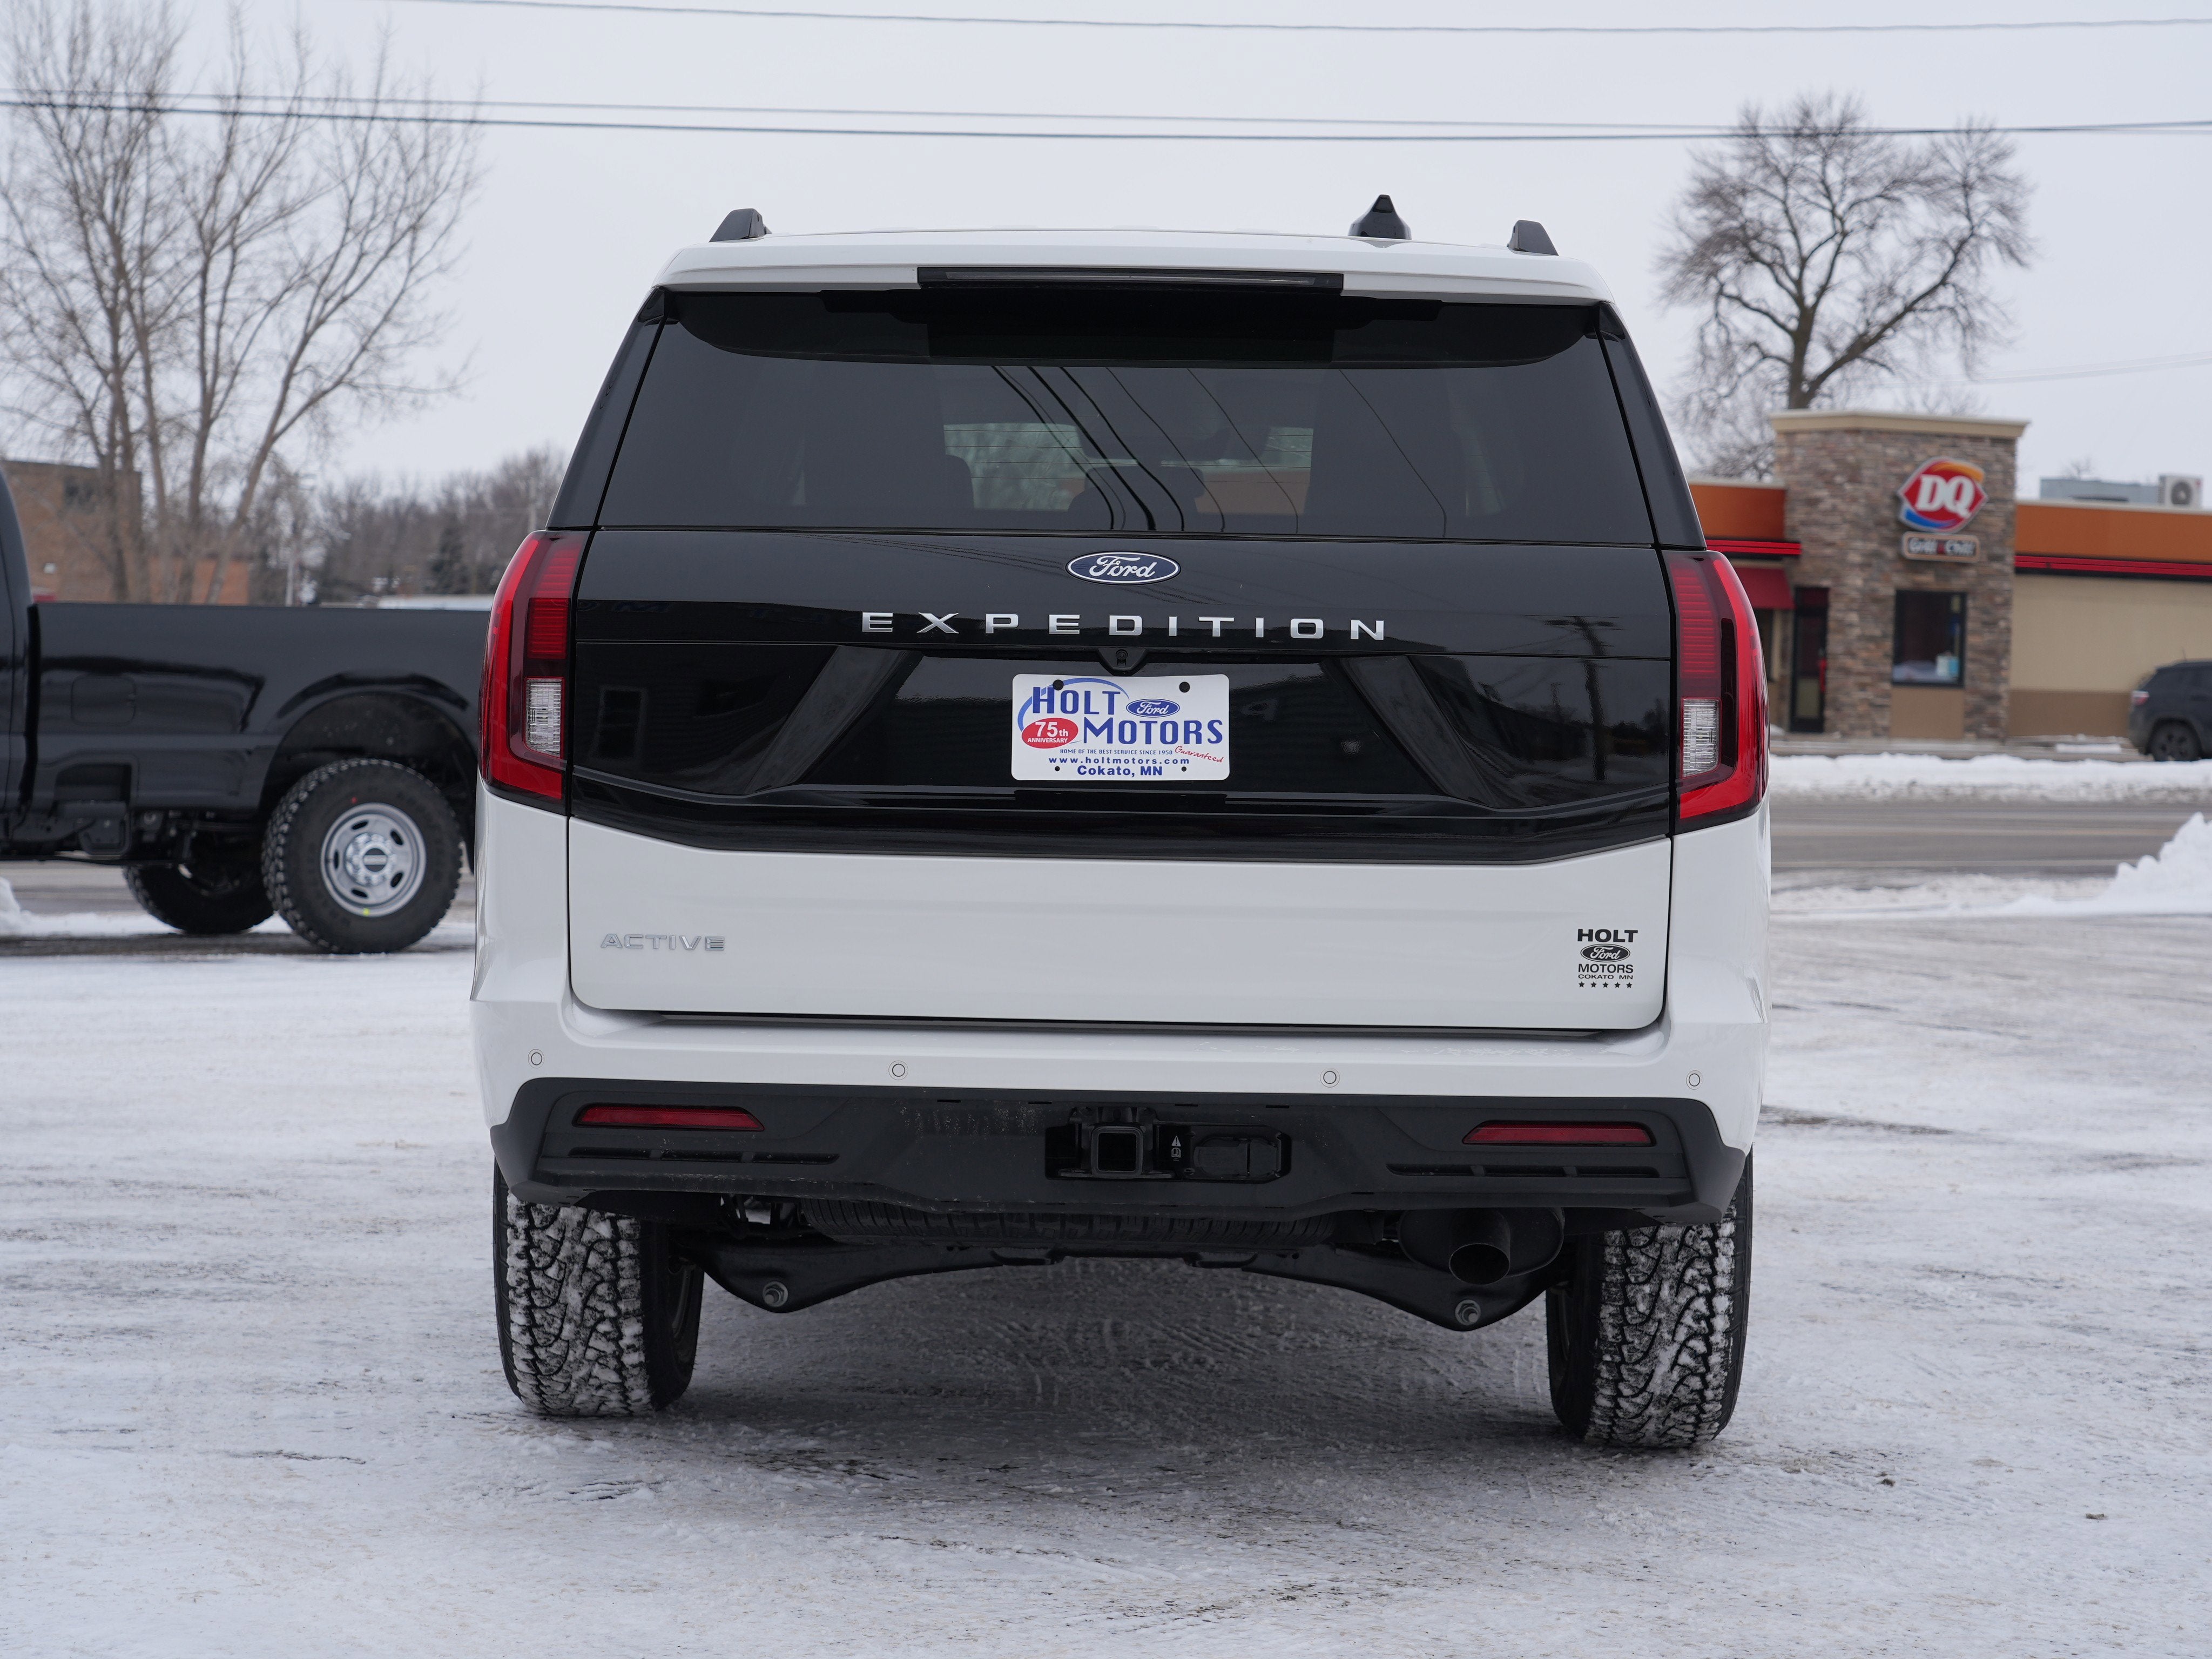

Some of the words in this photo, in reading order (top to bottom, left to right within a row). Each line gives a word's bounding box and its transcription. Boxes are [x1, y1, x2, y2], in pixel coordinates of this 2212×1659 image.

[1915, 474, 1975, 517] DQ
[1089, 556, 1158, 578] Ford
[862, 611, 1385, 640] EXPEDITION
[1033, 686, 1121, 715] HOLT
[1136, 701, 1170, 714] Ford
[1035, 721, 1069, 737] 75th
[1083, 716, 1223, 745] MOTORS
[1175, 745, 1224, 763] Guaranteed
[1077, 765, 1135, 778] Cokato,
[1140, 766, 1162, 775] MN
[600, 933, 725, 951] ACTIVE
[1577, 928, 1638, 943] HOLT
[1590, 946, 1621, 960] Ford
[1578, 963, 1634, 974] MOTORS
